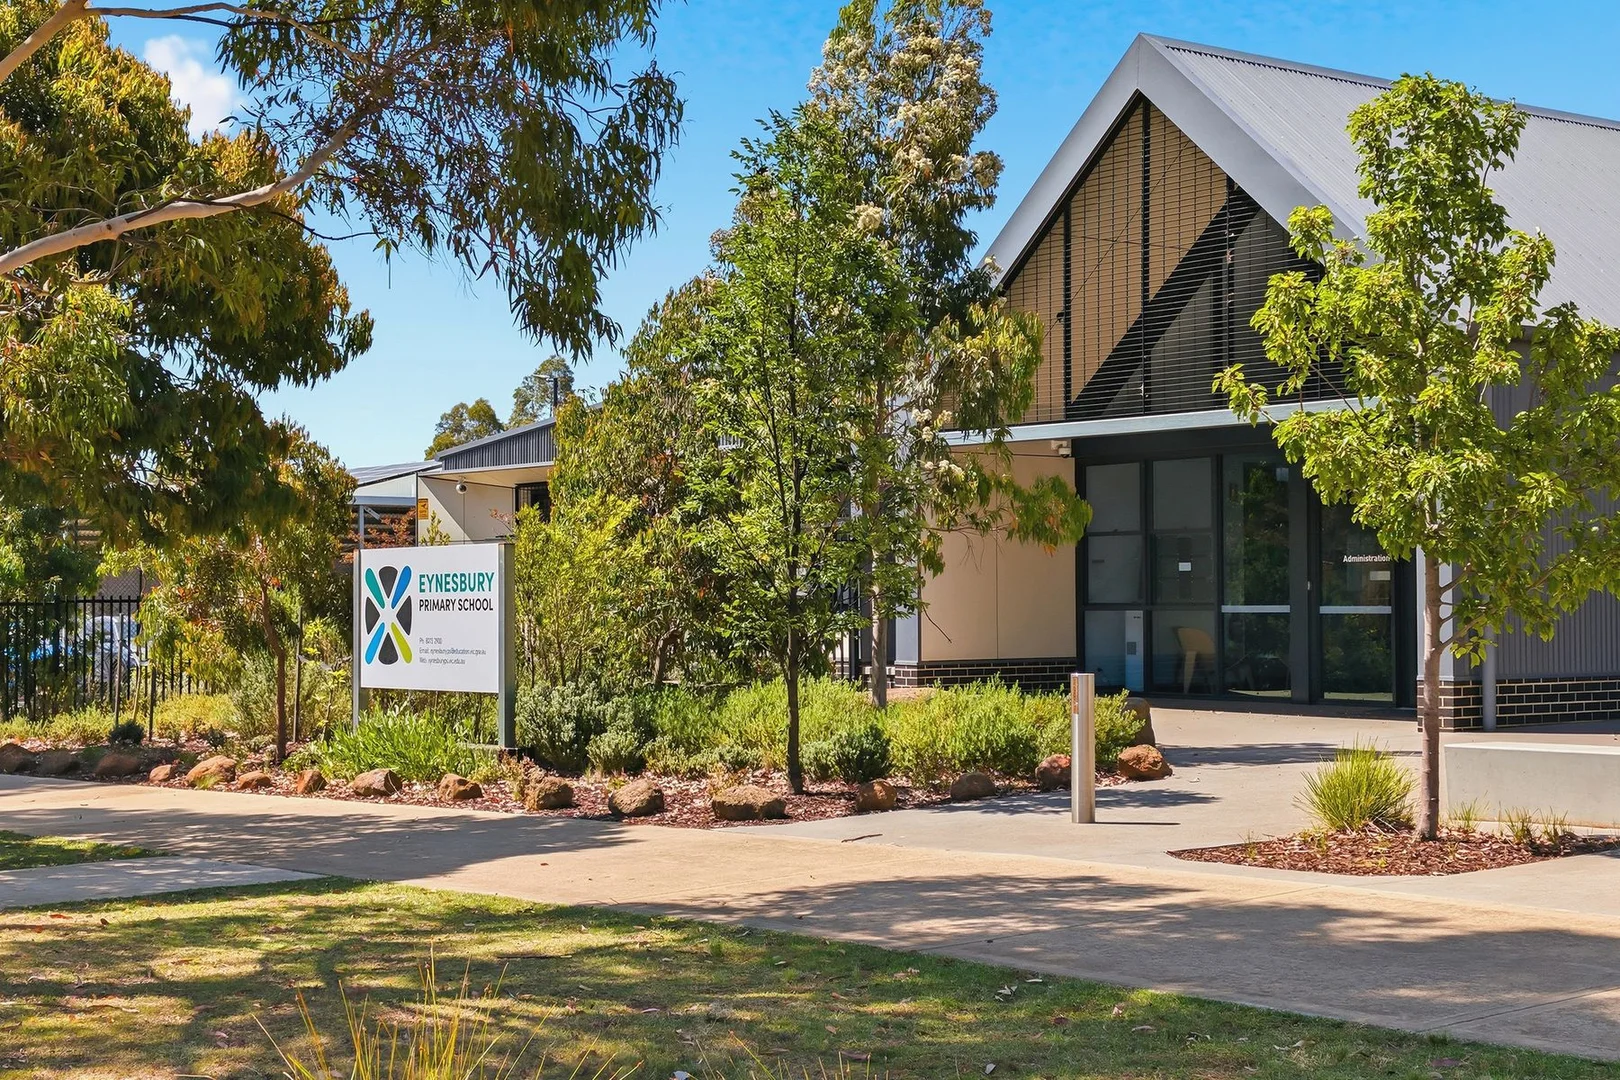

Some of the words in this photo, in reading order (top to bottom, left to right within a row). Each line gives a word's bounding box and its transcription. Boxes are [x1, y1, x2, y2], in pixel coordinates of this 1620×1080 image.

[1342, 554, 1391, 563] Administration
[419, 572, 495, 593] EYNESBURY
[419, 599, 457, 611] PRIMARY
[458, 598, 494, 611] SCHOOL
